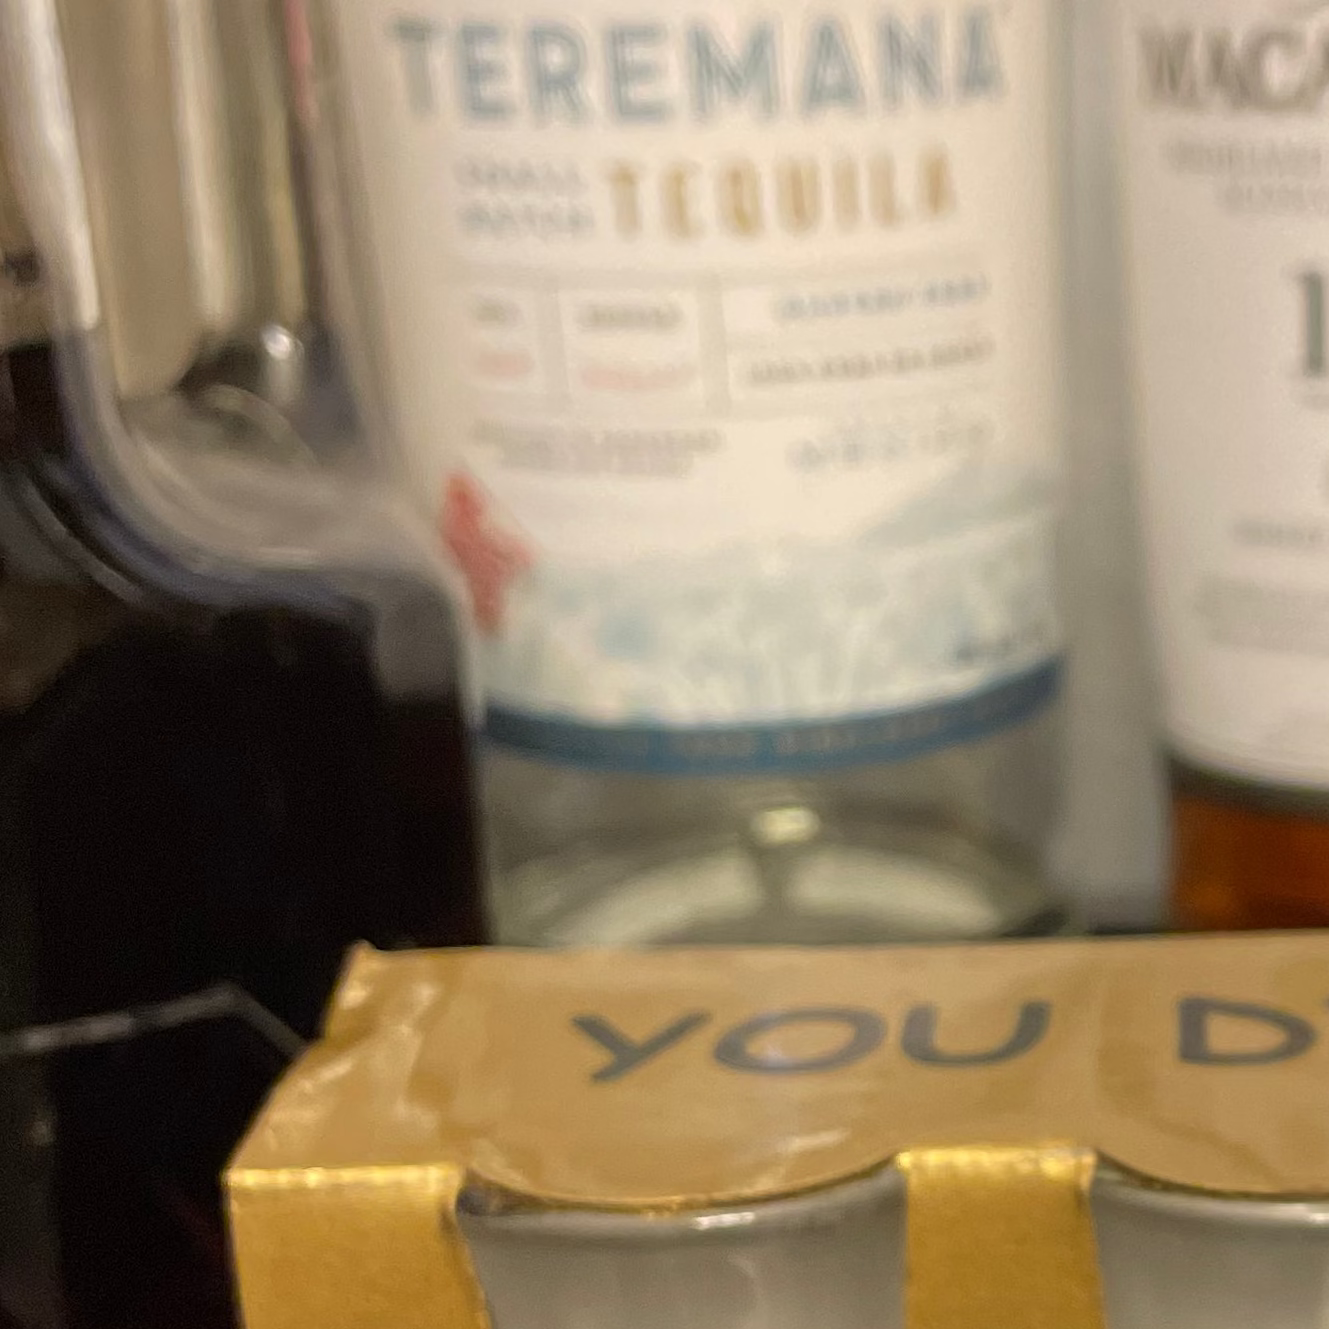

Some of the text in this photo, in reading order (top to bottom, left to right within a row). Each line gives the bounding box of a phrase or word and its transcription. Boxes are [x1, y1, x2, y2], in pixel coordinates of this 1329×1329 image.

[391, 9, 1003, 123] TEREMANA
[606, 144, 957, 241] TEQUILA
[572, 1000, 1053, 1083] YOU
